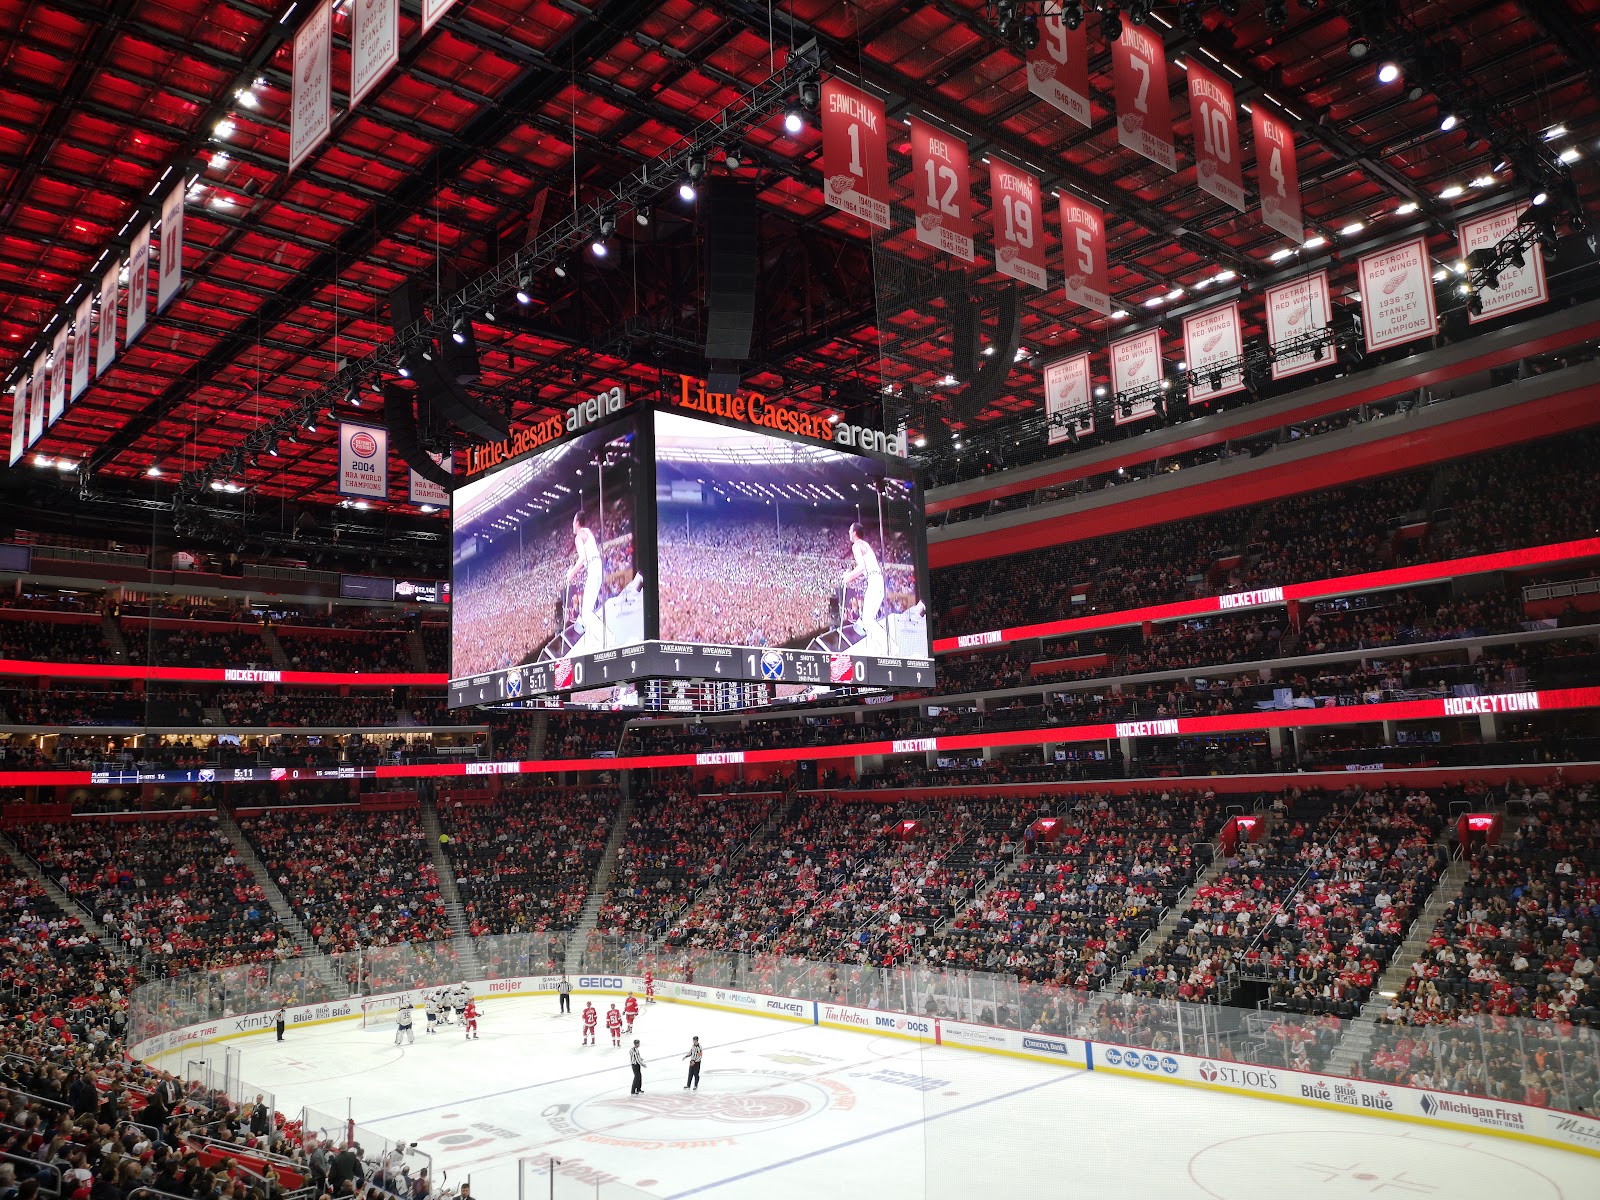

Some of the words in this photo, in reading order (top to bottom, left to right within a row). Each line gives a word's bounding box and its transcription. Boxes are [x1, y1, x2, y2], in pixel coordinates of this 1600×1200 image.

[360, 16, 387, 50] STANLEY
[367, 37, 380, 57] CUP
[1121, 27, 1154, 64] LINDSAY
[357, 39, 391, 84] CHAMPIONS
[1130, 53, 1150, 113] 7
[298, 90, 321, 120] STANLEY
[1054, 88, 1083, 114] 1946-1971
[829, 93, 877, 134] SAWCHUK
[295, 114, 324, 150] CHAMPIONS
[1200, 101, 1231, 164] 10
[1263, 120, 1284, 148] KELLY
[847, 123, 863, 177] 1
[929, 137, 952, 163] ABEL
[1269, 147, 1287, 198] 4
[925, 159, 960, 218] 12
[999, 174, 1033, 204] YZERMAN
[1002, 195, 1034, 249] 19
[1475, 215, 1517, 235] DETROIT
[1471, 235, 1489, 247] RED
[164, 225, 177, 279] 11
[1075, 227, 1094, 275] 5
[1373, 250, 1410, 269] DETROIT
[1369, 270, 1385, 280] RED
[1389, 258, 1418, 274] WINGS
[131, 262, 145, 316] 15
[1279, 284, 1312, 301] DETROIT
[1275, 302, 1290, 311] RED
[1293, 291, 1319, 305] WINGS
[1379, 291, 1415, 309] 1936-37
[1379, 301, 1417, 319] STANLEY
[1390, 313, 1408, 325] CUP
[102, 299, 115, 348] 16
[1192, 329, 1205, 339] RED
[1207, 320, 1231, 334] WINGS
[1195, 313, 1225, 329] DETROIT
[1376, 318, 1426, 339] CHAMPIONS
[75, 330, 88, 375] 21
[1121, 340, 1148, 354] DETROIT
[1132, 346, 1153, 358] WINGS
[52, 357, 65, 401] 32
[679, 374, 745, 421] Little
[747, 393, 833, 441] Caesars
[835, 421, 900, 456] arena
[465, 440, 502, 477] Little
[502, 415, 564, 459] Caesars
[566, 386, 625, 432] arena
[352, 460, 375, 473] 2004
[345, 471, 358, 479] NBA
[360, 473, 382, 482] WORLD
[345, 480, 382, 491] CHAMPIONS
[415, 489, 448, 500] CHAMPIONS
[1219, 587, 1285, 608] HOCKEYTOWN
[958, 630, 1002, 648] HOCKEYTOWN
[660, 644, 693, 653] TAKEAWAYS
[702, 647, 732, 655] GIVEAWAYS
[785, 652, 794, 661] 16
[821, 654, 830, 664] 15
[574, 662, 583, 684] 0
[603, 665, 607, 678] 1
[630, 660, 636, 674] 9
[674, 659, 680, 672] 1
[714, 660, 721, 674] 4
[747, 654, 756, 677] 1
[796, 662, 819, 677] 5:11
[854, 661, 866, 682] 0
[225, 669, 281, 682] HOCKEYTOWN
[529, 673, 546, 689] 5:11
[888, 670, 892, 681] 1
[916, 672, 922, 683] 9
[498, 676, 504, 697] 1
[1442, 691, 1539, 715] HOCKEYTOWN
[1115, 718, 1179, 737] HOCKEYTOWN
[892, 738, 937, 753] HOCKEYTOWN
[696, 752, 744, 765] HOCKEYTOWN
[234, 768, 253, 777] 5:11
[292, 769, 299, 779] 0
[465, 761, 520, 775] HOCKEYTOWN
[489, 980, 522, 993] meijer
[579, 977, 623, 988] GEICO
[681, 987, 707, 999] Huntington
[332, 1007, 351, 1017] Blue
[767, 1000, 803, 1013] FALKEN
[235, 1013, 276, 1032] xfinity
[293, 1013, 313, 1023] Blue
[402, 1012, 411, 1020] 35
[588, 1014, 595, 1022] 21
[824, 1006, 839, 1022] Tim
[840, 1009, 869, 1026] Hortons
[875, 1016, 895, 1028] DMC
[907, 1021, 928, 1033] DOCS
[200, 1026, 217, 1037] TIRE
[1050, 1043, 1065, 1052] Bank
[1220, 1067, 1240, 1084] ST.
[1241, 1071, 1277, 1089] JOE'S
[1301, 1084, 1331, 1101] Blue
[1334, 1085, 1356, 1097] Blue
[1361, 1094, 1394, 1111] Blue
[1439, 1099, 1494, 1118] Michigan
[1496, 1108, 1523, 1123] First
[470, 1122, 522, 1139] BELFOR
[1480, 1117, 1503, 1127] CREDIT
[1504, 1121, 1525, 1130] UNION
